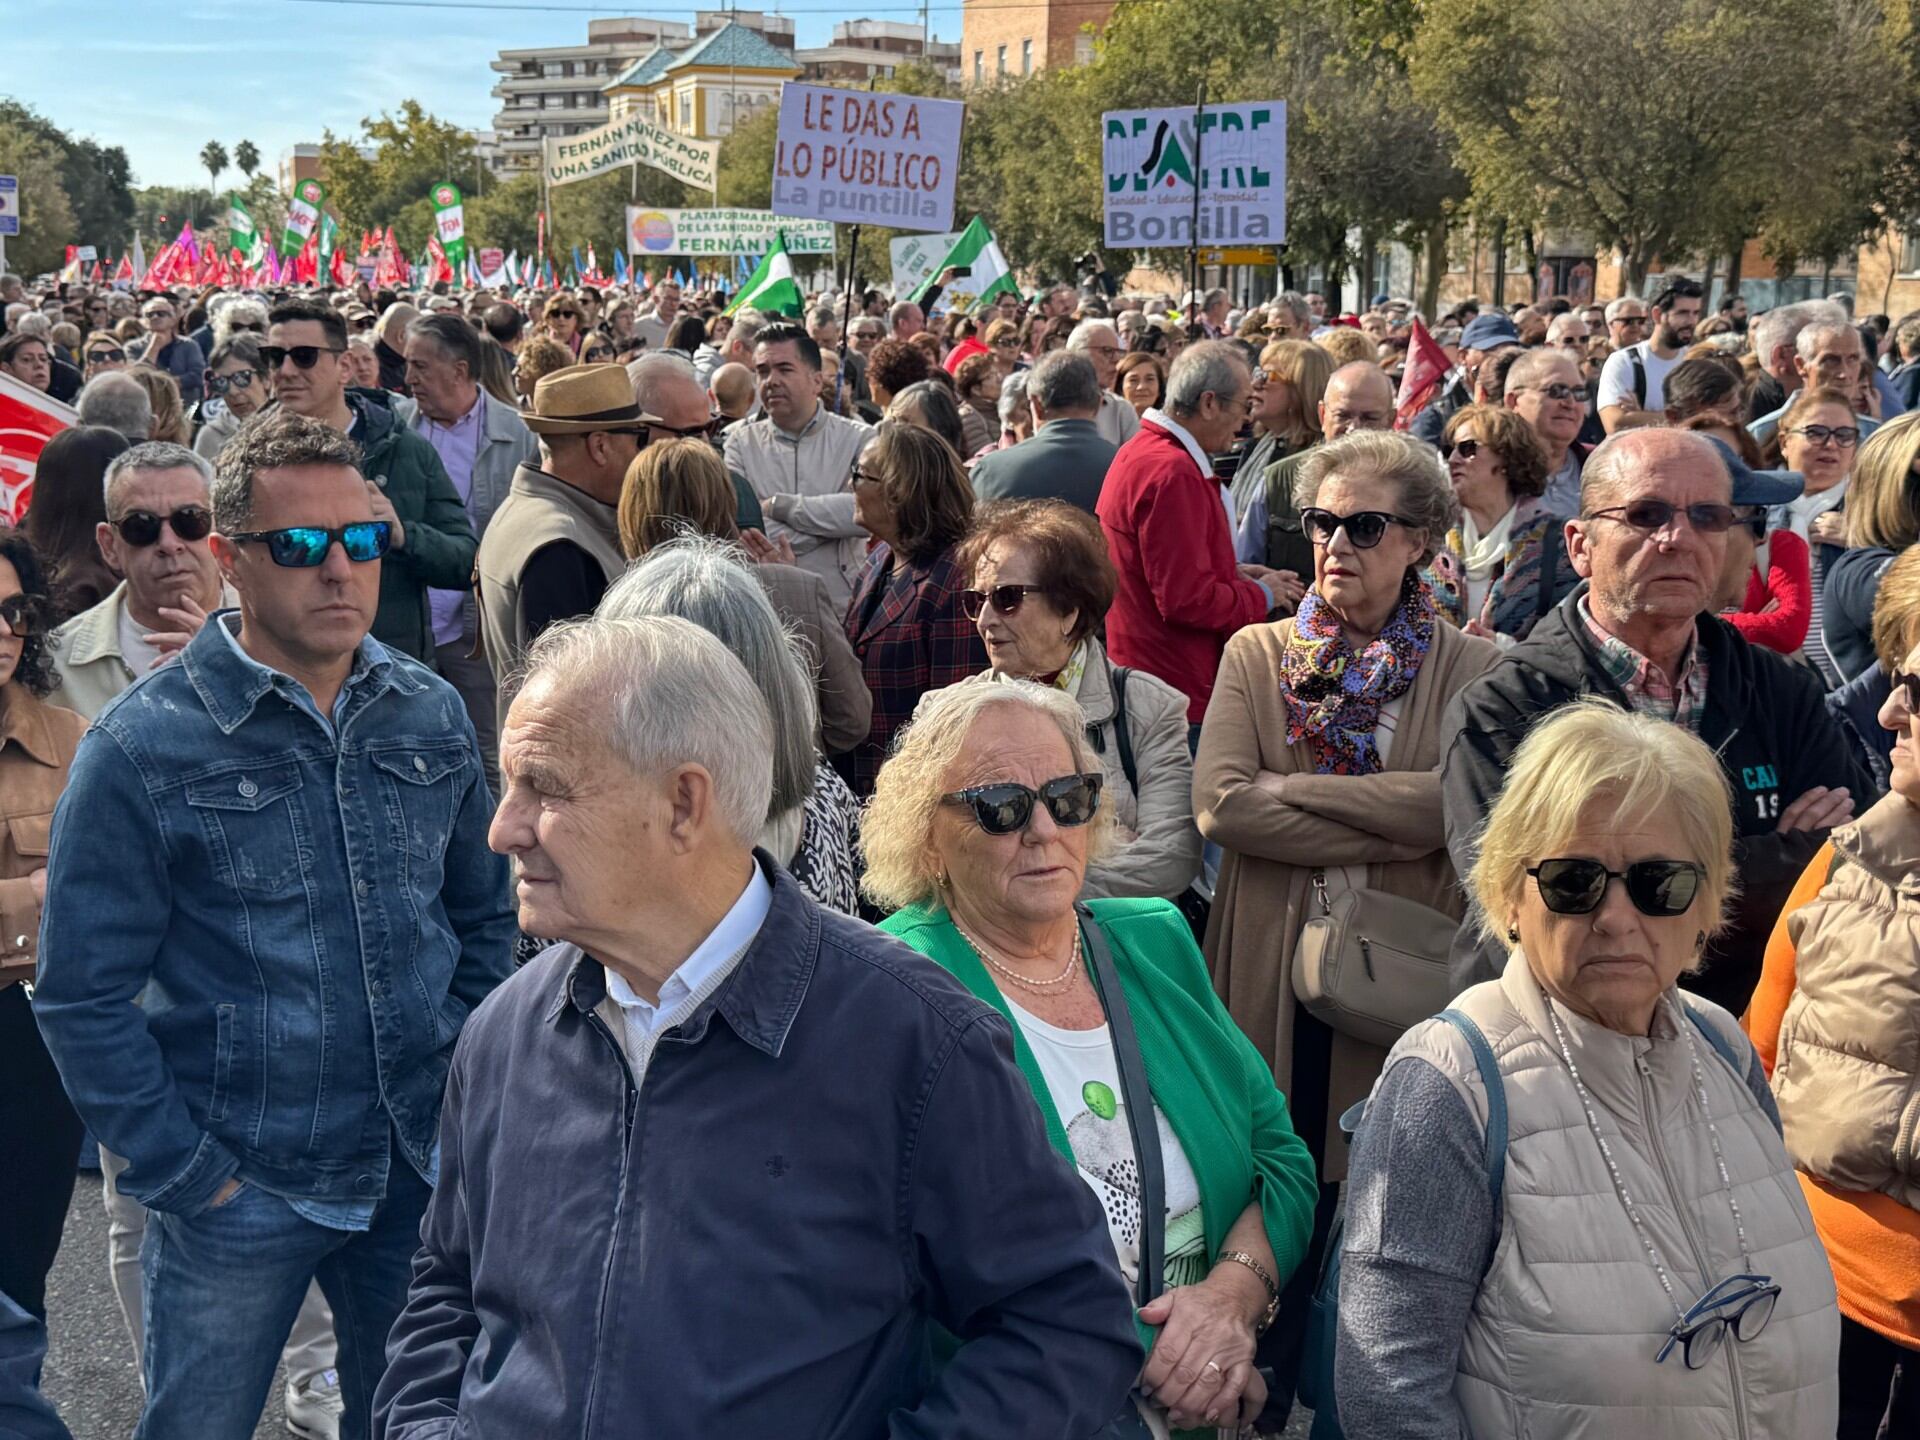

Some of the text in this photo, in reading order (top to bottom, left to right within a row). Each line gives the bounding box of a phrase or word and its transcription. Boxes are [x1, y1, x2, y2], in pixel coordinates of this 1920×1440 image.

[804, 93, 921, 141] LE DAS A
[559, 127, 623, 159] FERNÁN
[677, 143, 710, 164] POR
[551, 162, 588, 180] UNA
[777, 137, 941, 192] LO PÚBLICO
[774, 180, 938, 218] La puntilla
[1157, 193, 1206, 205] Educacin
[677, 223, 693, 232] DE
[695, 223, 711, 232] LA
[714, 223, 764, 233] SANIDAD
[816, 222, 832, 231] DE
[680, 211, 758, 221] PLATAFORMA
[1109, 205, 1270, 242] Bonilla
[679, 234, 760, 251] FERNÁN
